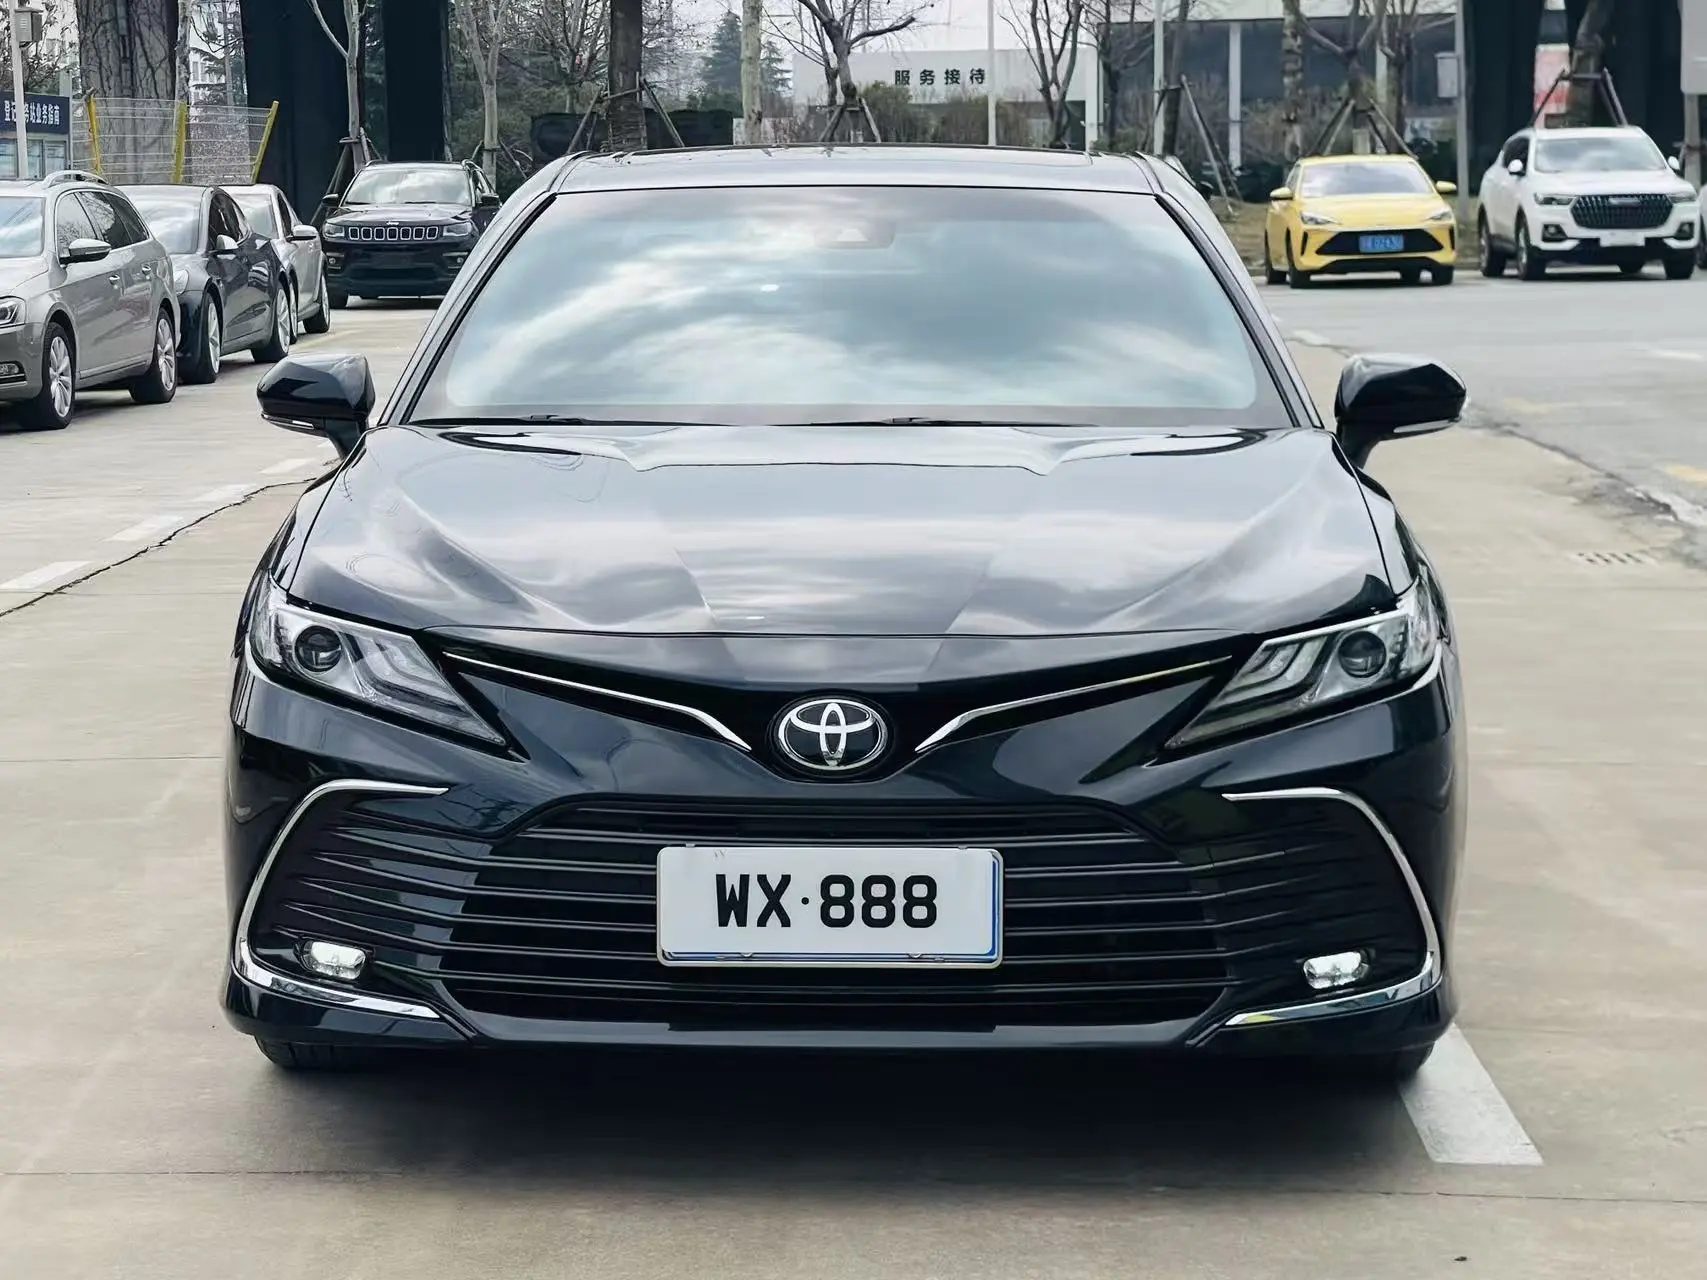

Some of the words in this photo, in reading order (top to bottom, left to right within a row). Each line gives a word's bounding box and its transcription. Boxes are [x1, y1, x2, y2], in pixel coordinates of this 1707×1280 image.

[895, 68, 985, 86] 服务接待
[4, 100, 60, 125] 登记务站业务指南
